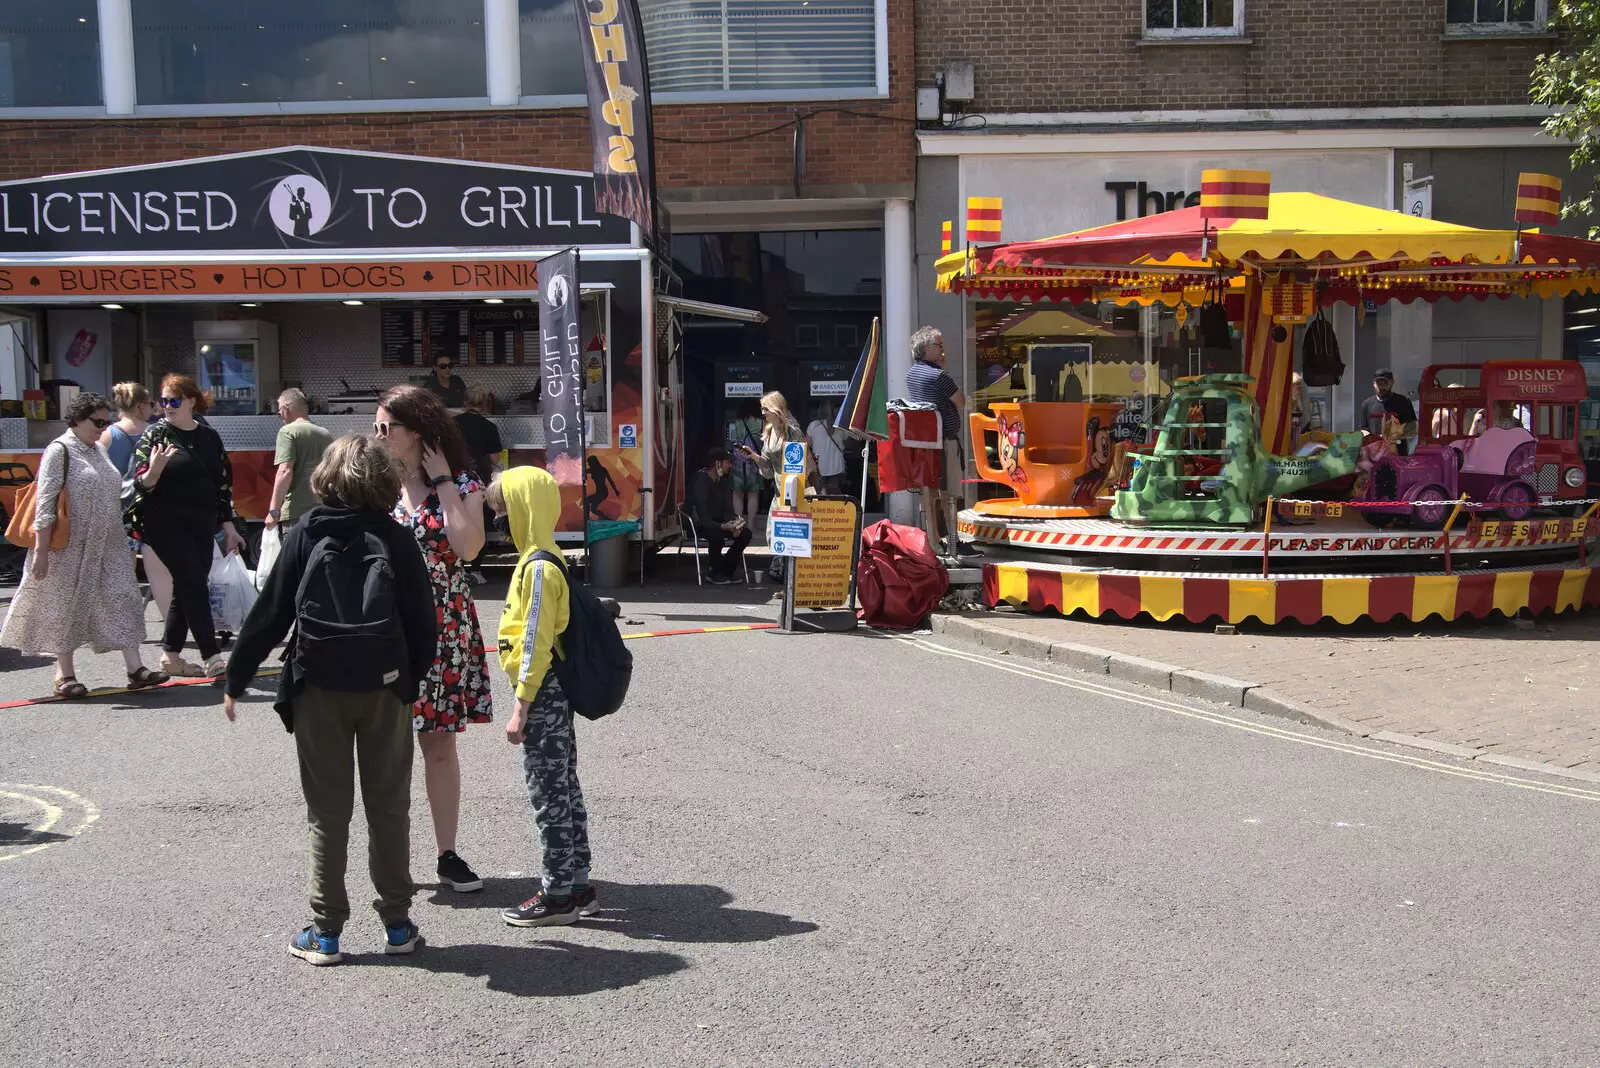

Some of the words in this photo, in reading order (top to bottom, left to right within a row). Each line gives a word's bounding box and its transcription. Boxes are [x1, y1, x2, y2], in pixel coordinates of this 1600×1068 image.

[1106, 181, 1201, 220] Thr
[0, 191, 237, 235] LICENSED
[353, 187, 427, 231] TO
[460, 186, 601, 229] GRILL
[59, 268, 197, 291] BURGERS
[242, 267, 307, 290] HOT
[322, 265, 405, 288] DOGS
[452, 263, 538, 287] DRINK
[1506, 369, 1565, 382] DISNEY
[1519, 384, 1555, 394] TOURS
[1281, 504, 1341, 516] ENTRANCE
[1470, 524, 1518, 537] PLEASE
[1521, 523, 1559, 536] STAND
[1269, 538, 1330, 551] PLEASE
[1335, 538, 1385, 550] STAND
[1388, 537, 1436, 550] CLEAR
